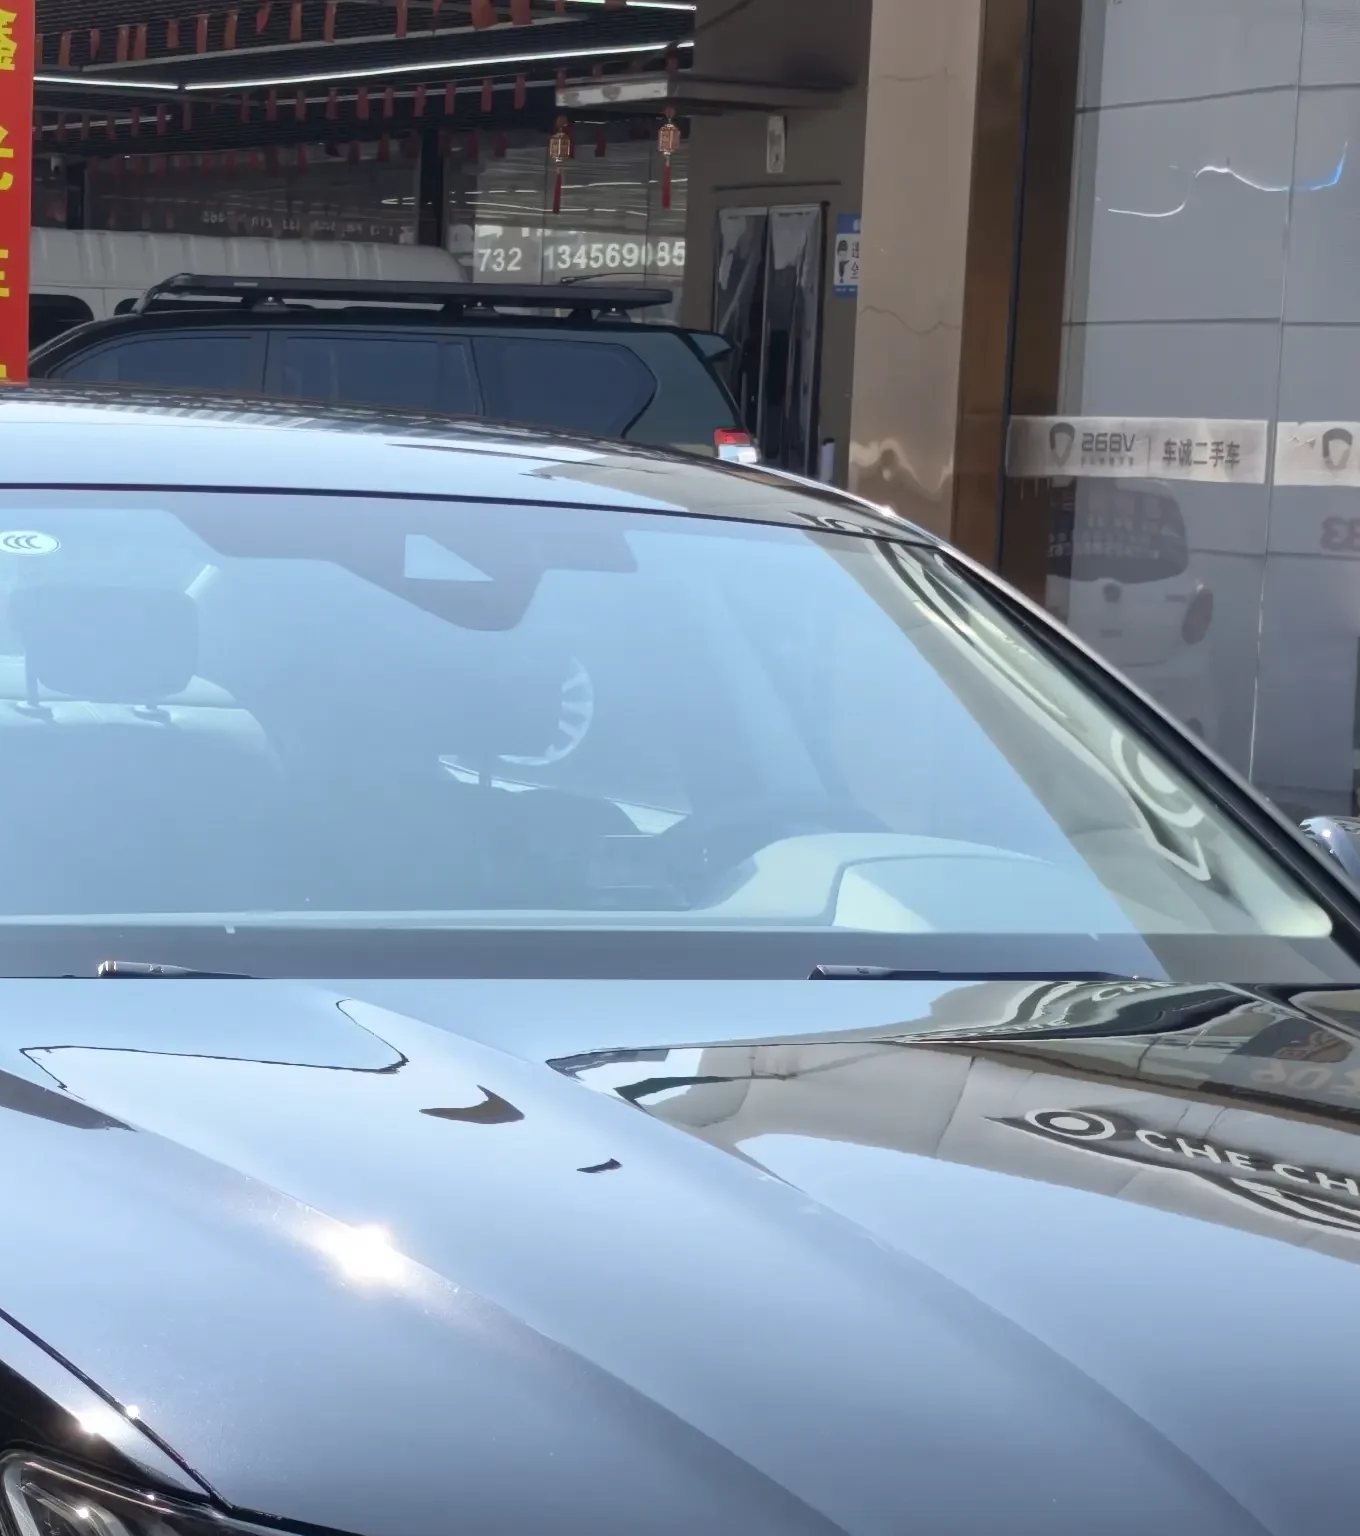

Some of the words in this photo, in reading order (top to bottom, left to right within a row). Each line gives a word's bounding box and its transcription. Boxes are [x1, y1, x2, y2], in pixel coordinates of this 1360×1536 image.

[1081, 432, 1136, 453] 268V
[1162, 438, 1240, 469] 车诚二手车
